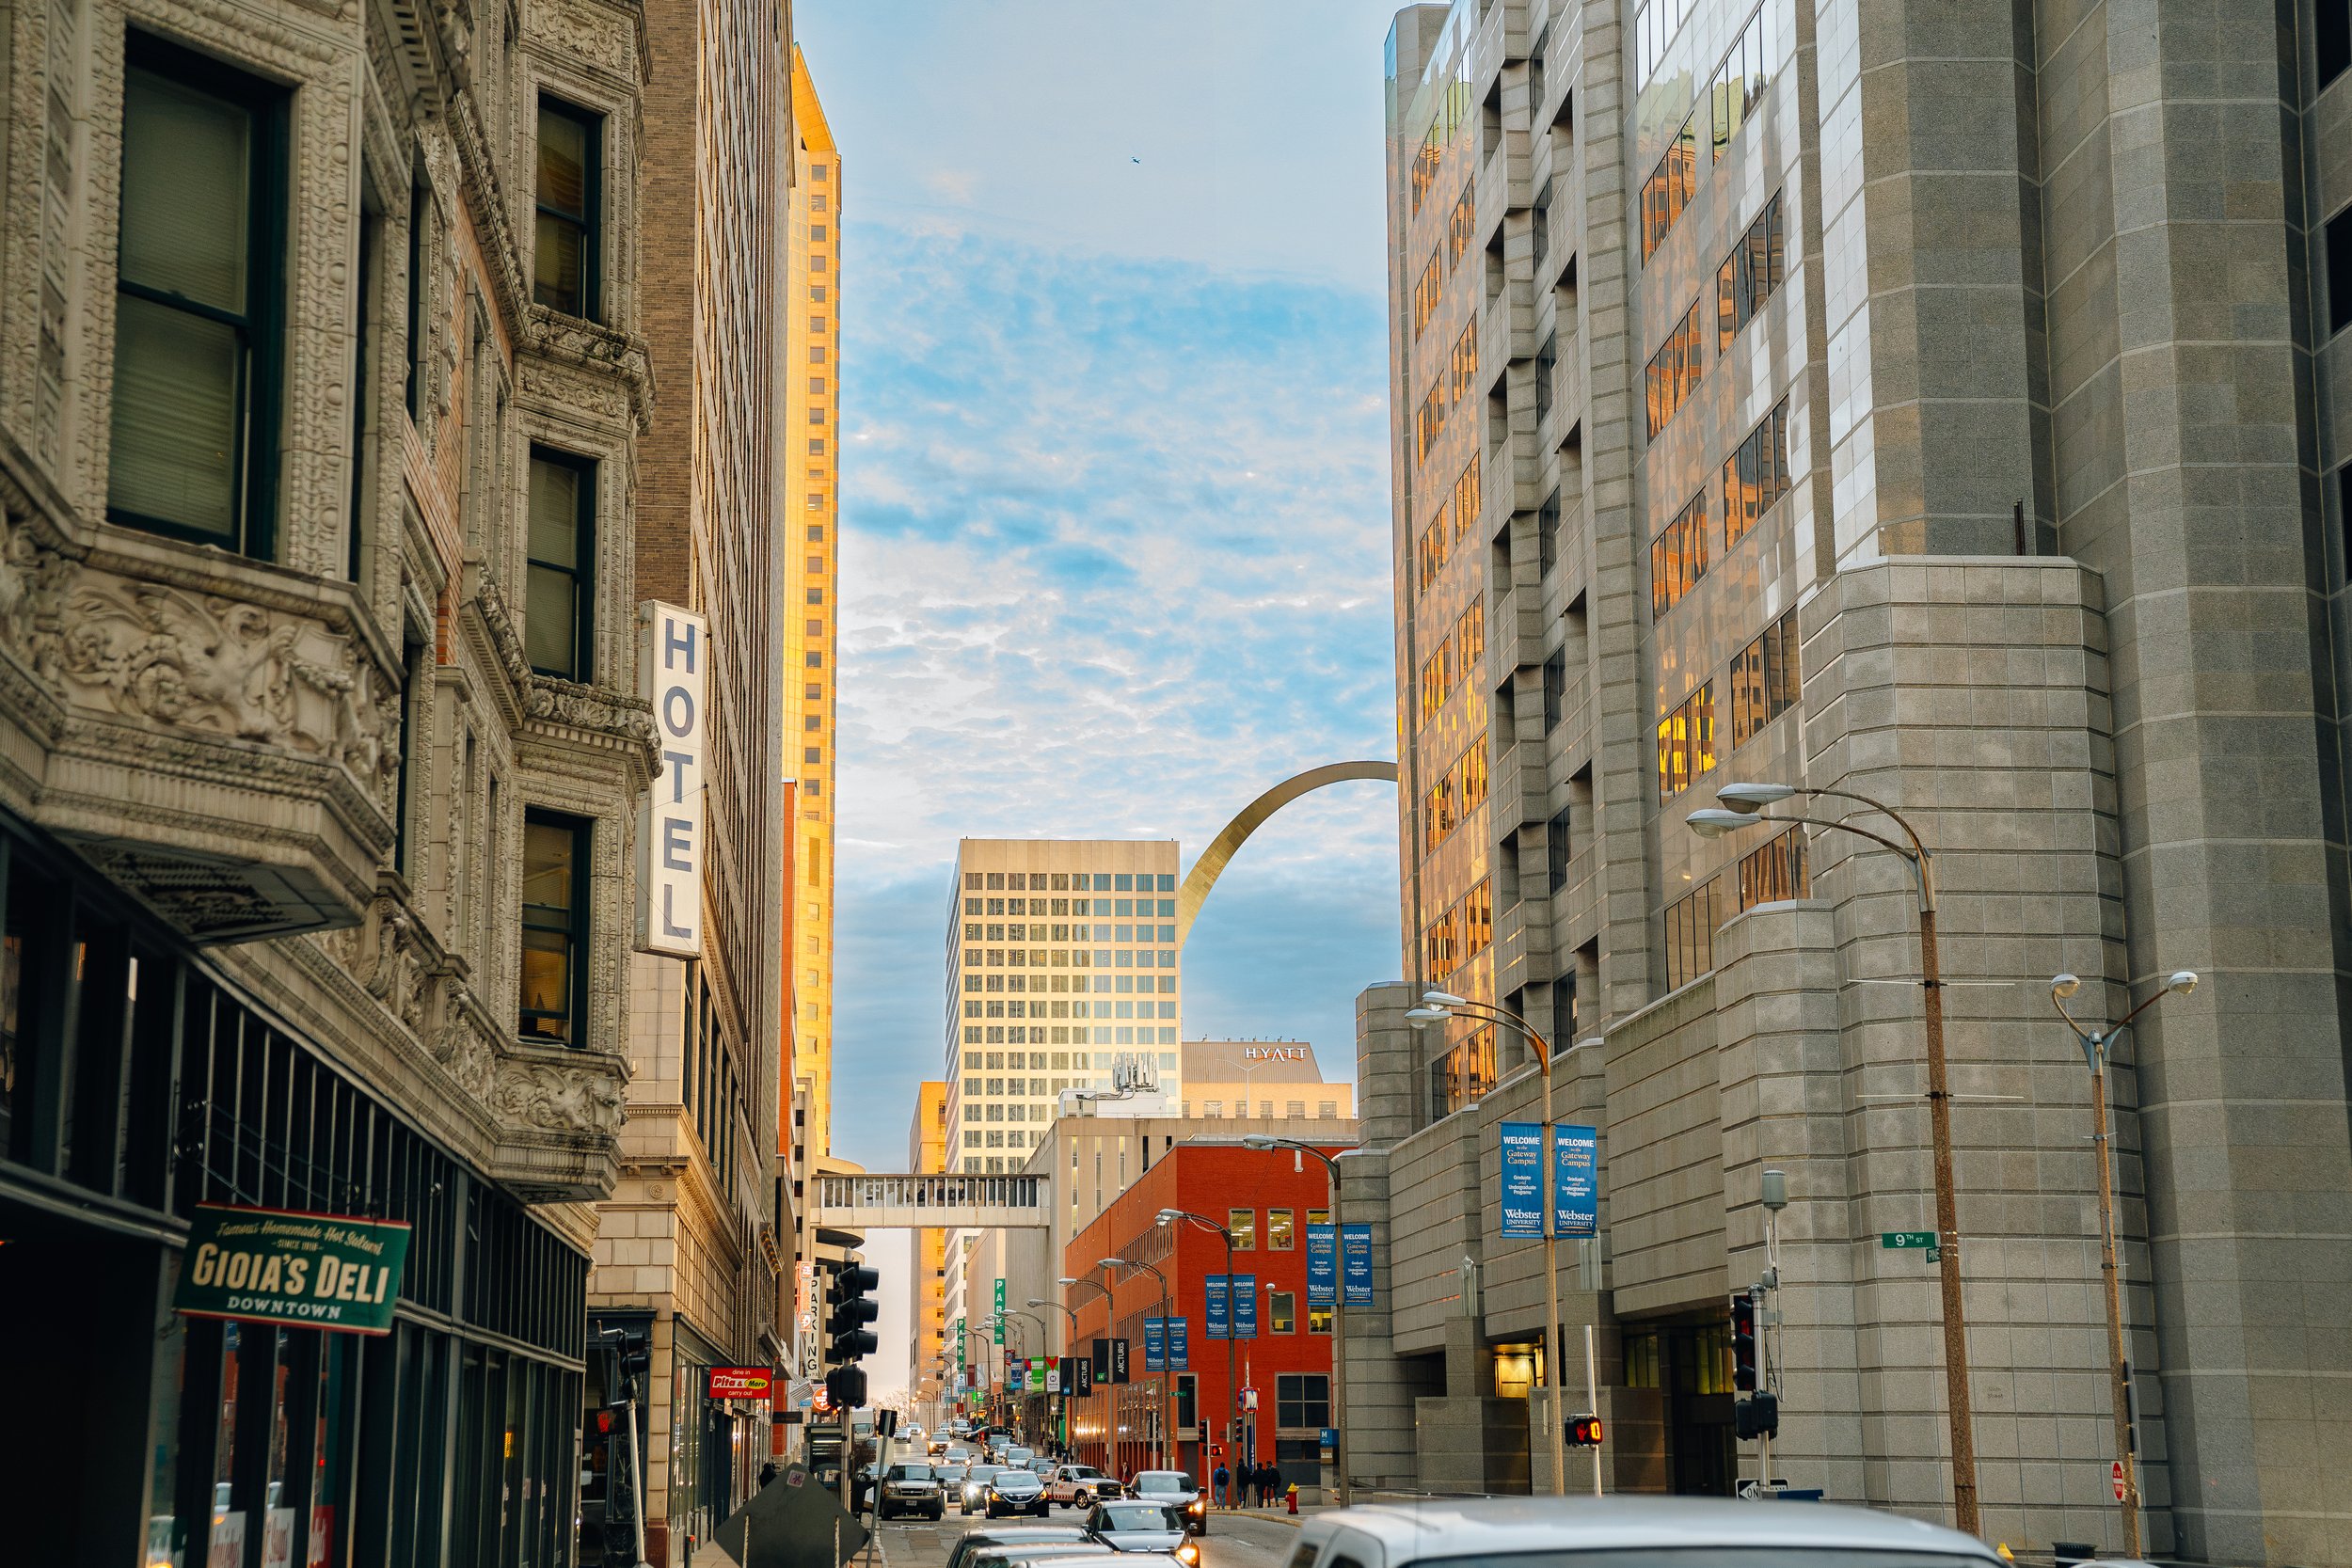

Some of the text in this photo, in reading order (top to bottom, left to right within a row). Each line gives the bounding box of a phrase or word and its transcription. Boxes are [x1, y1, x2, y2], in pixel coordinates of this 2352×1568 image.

[663, 618, 695, 940] HOTEL
[1246, 1047, 1307, 1062] HYATT
[1503, 1136, 1540, 1145] WELCOME
[1558, 1138, 1594, 1147] WELCOME
[1506, 1149, 1536, 1159] Gateway
[1561, 1151, 1591, 1161] Gateway
[1507, 1157, 1536, 1165] Campus
[1562, 1159, 1591, 1167] Campus
[1504, 1209, 1541, 1218] Webster
[1558, 1210, 1594, 1220] Webster
[261, 1220, 323, 1240] Homemade
[324, 1226, 344, 1243] Hot
[344, 1231, 385, 1257] Salami
[1895, 1234, 1915, 1246] 9TH
[1928, 1248, 1940, 1261] PINE
[192, 1242, 390, 1305] GIOIA'S DELI
[227, 1296, 342, 1320] DOWNTOWN
[995, 1280, 1004, 1327] PARK
[807, 1280, 818, 1370] PARKING
[713, 1375, 736, 1387] Pita
[1747, 1488, 1759, 1498] ON
